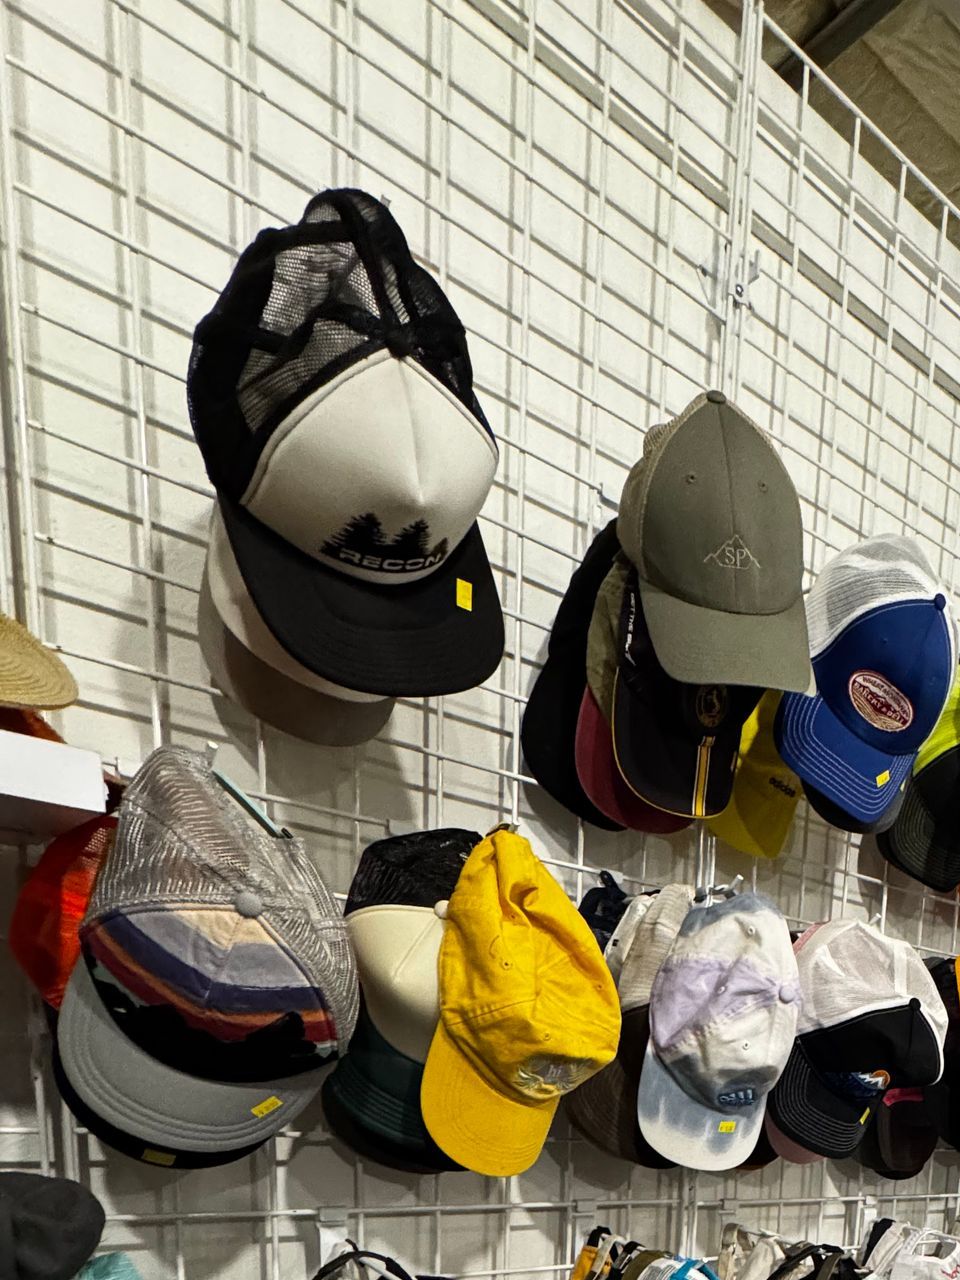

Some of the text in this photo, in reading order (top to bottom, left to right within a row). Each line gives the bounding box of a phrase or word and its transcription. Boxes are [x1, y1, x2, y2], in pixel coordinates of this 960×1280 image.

[339, 548, 441, 571] RECON
[725, 546, 746, 568] SP
[852, 681, 881, 710] BAKERY
[768, 776, 796, 798] adidas
